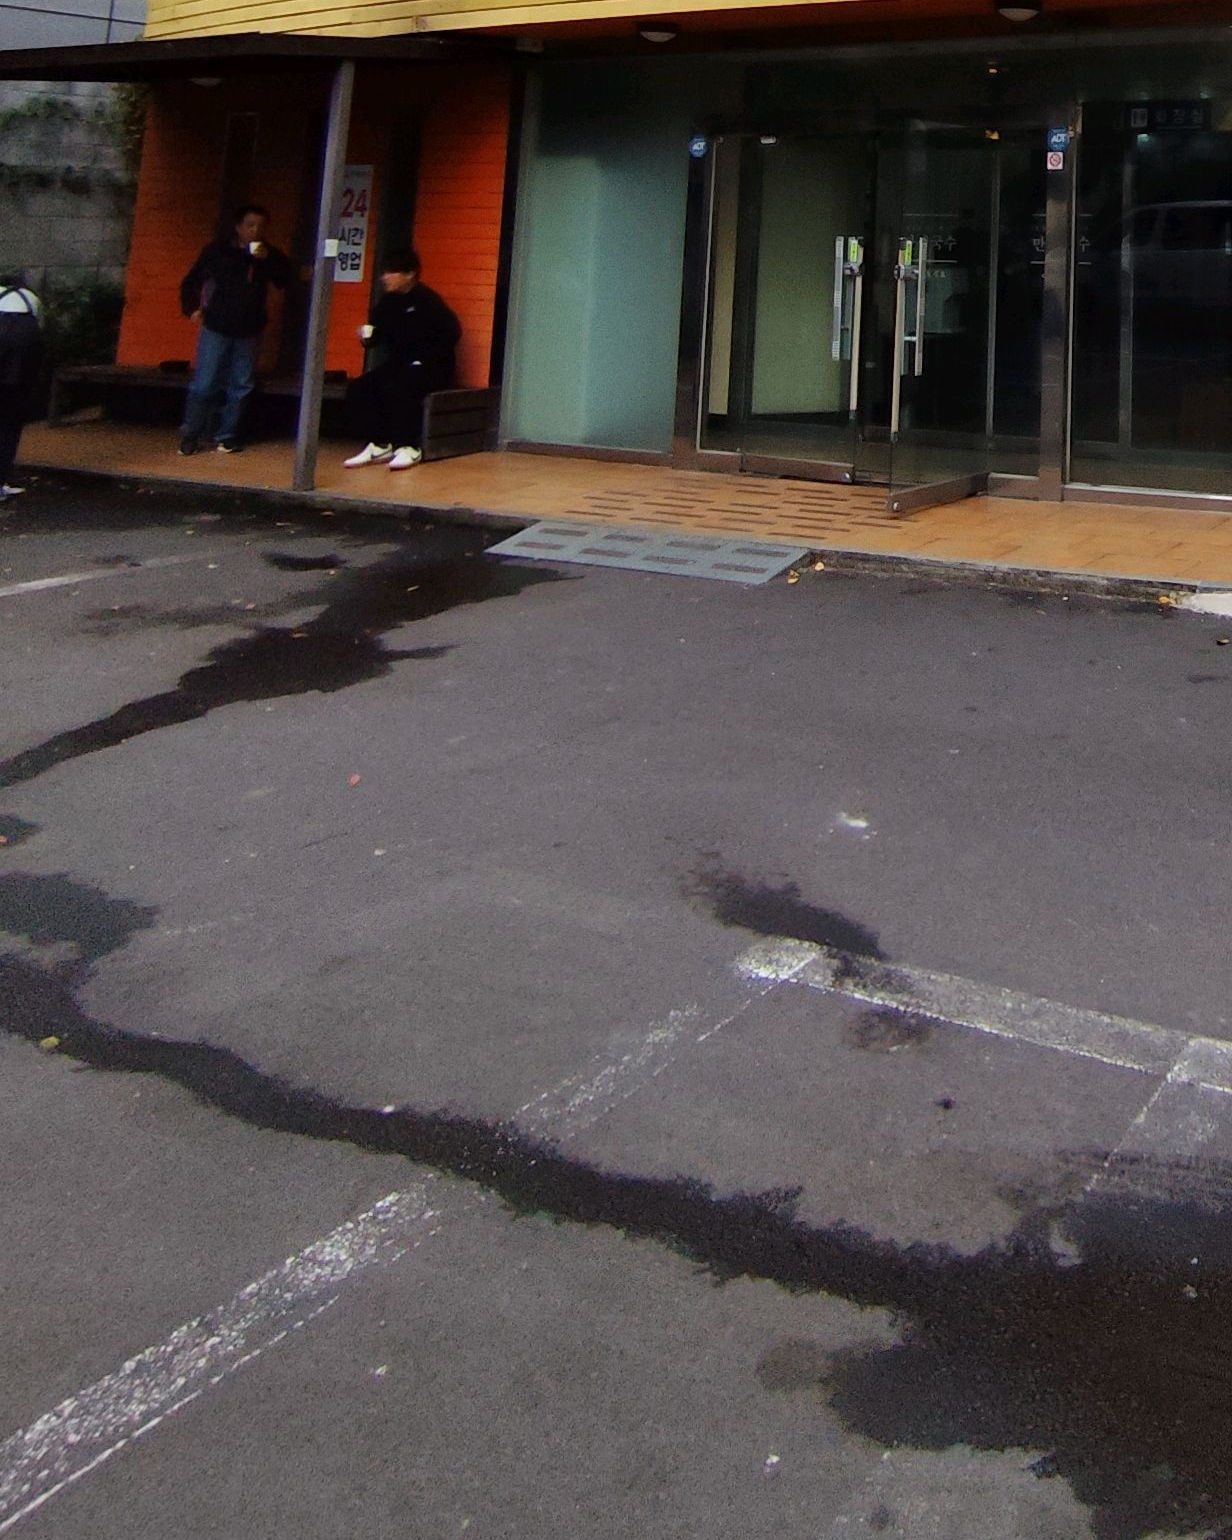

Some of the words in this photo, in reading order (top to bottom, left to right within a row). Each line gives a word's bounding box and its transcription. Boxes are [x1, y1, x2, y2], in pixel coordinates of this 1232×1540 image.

[1051, 133, 1068, 143] ADT
[341, 187, 367, 218] 24
[339, 226, 364, 246] 시간
[337, 252, 362, 272] 영업
